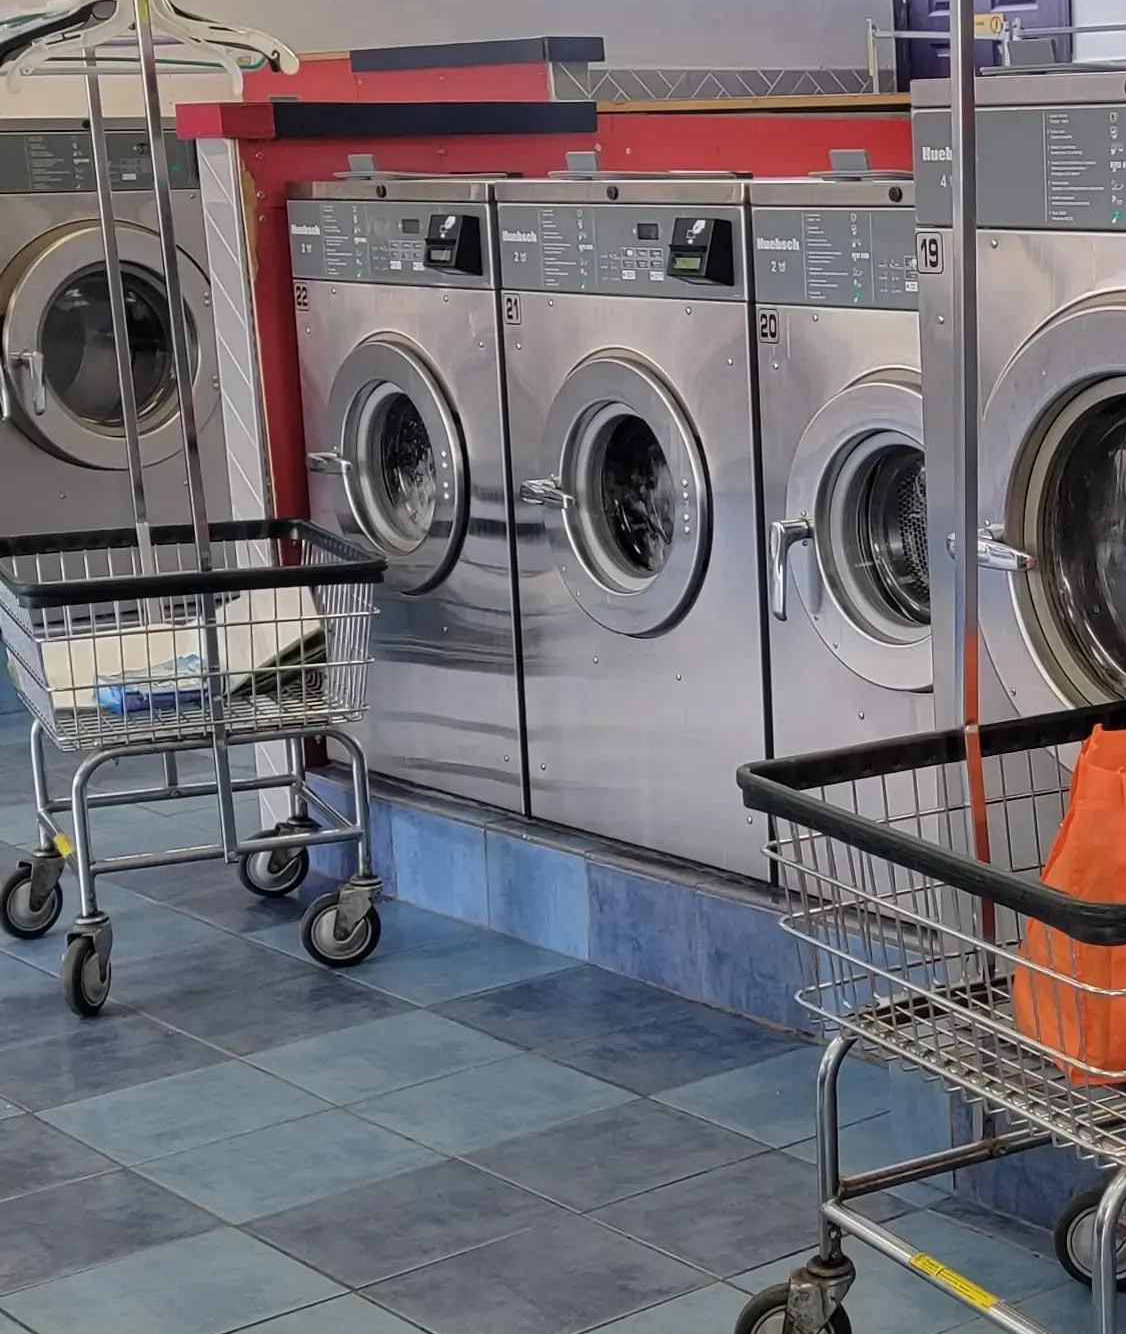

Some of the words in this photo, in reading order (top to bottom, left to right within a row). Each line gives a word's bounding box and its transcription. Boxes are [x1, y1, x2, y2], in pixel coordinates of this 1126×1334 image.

[940, 174, 947, 187] 4
[756, 237, 801, 251] Huebsch
[920, 237, 940, 268] 19
[770, 260, 777, 273] 2
[295, 285, 309, 307] 22
[506, 297, 519, 320] 21
[760, 313, 777, 339] 20
